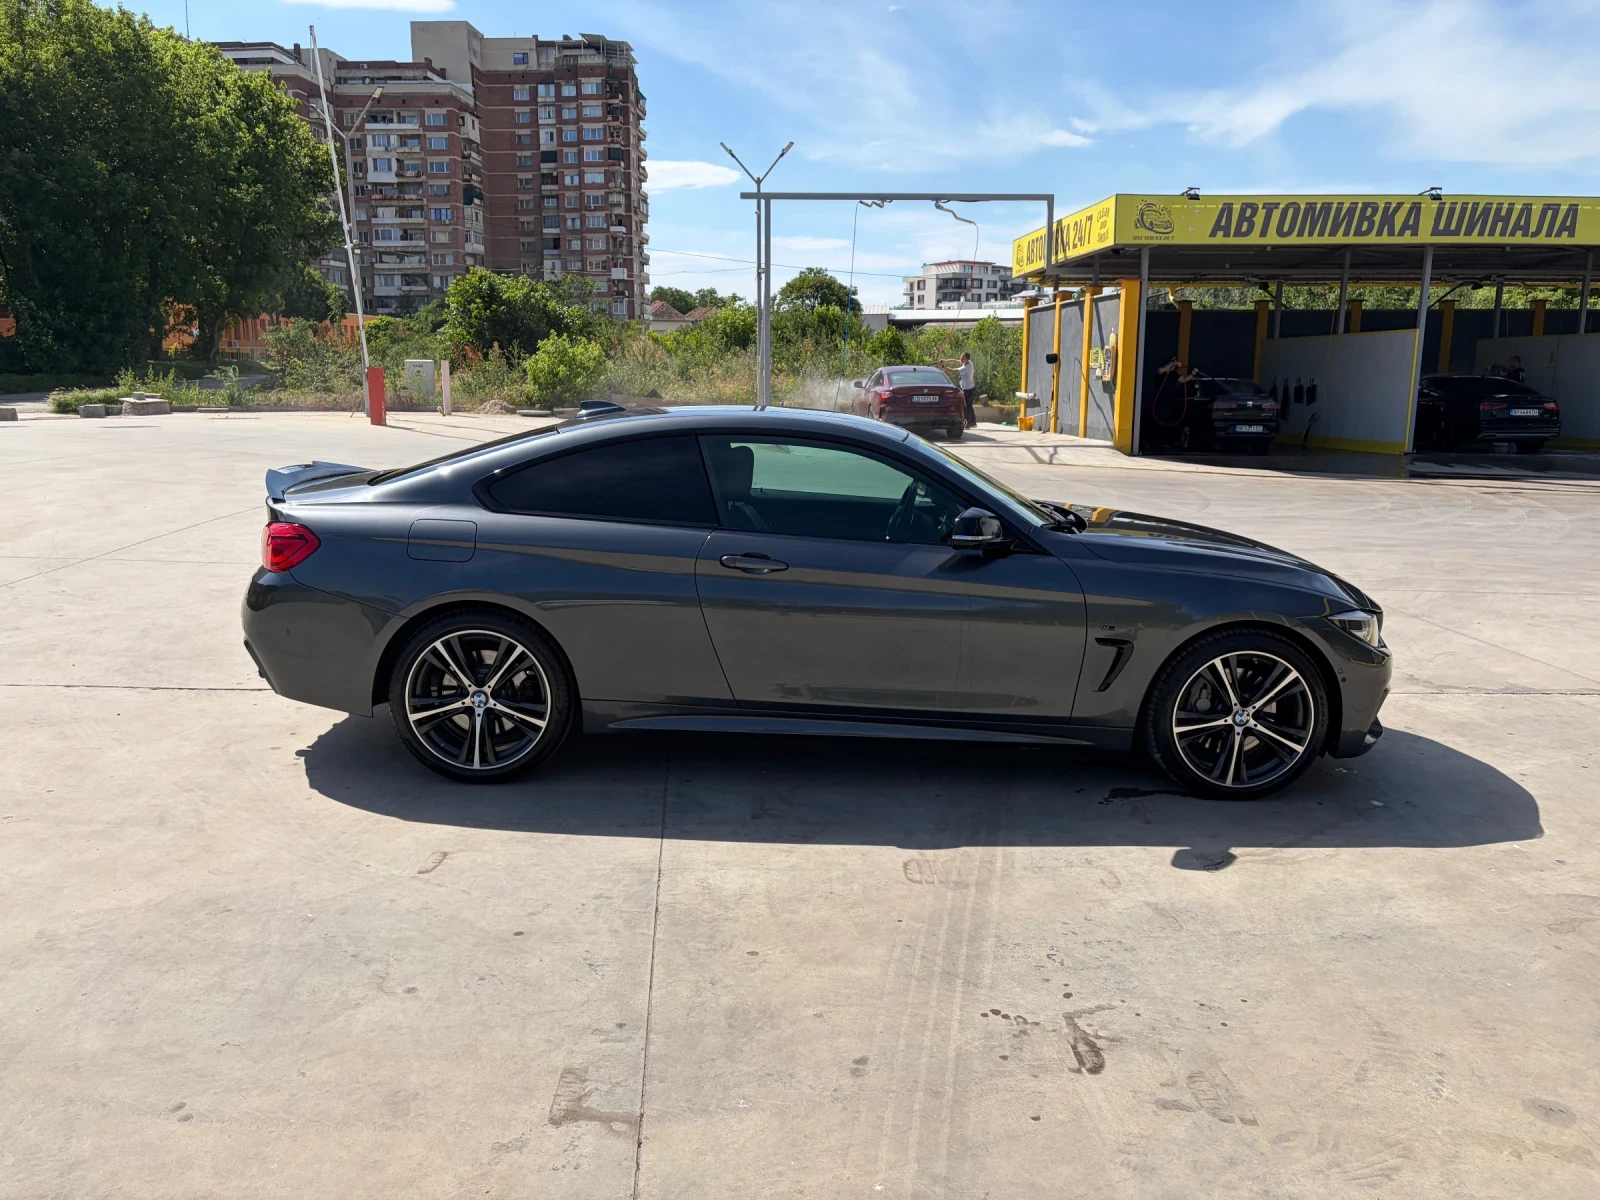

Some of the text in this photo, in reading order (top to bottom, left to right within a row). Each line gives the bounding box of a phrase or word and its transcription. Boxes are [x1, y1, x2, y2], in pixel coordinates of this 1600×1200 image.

[1026, 214, 1093, 266] АВТОВКА 24/7
[1208, 202, 1579, 238] АВТОМИВКА ШИНАЛА
